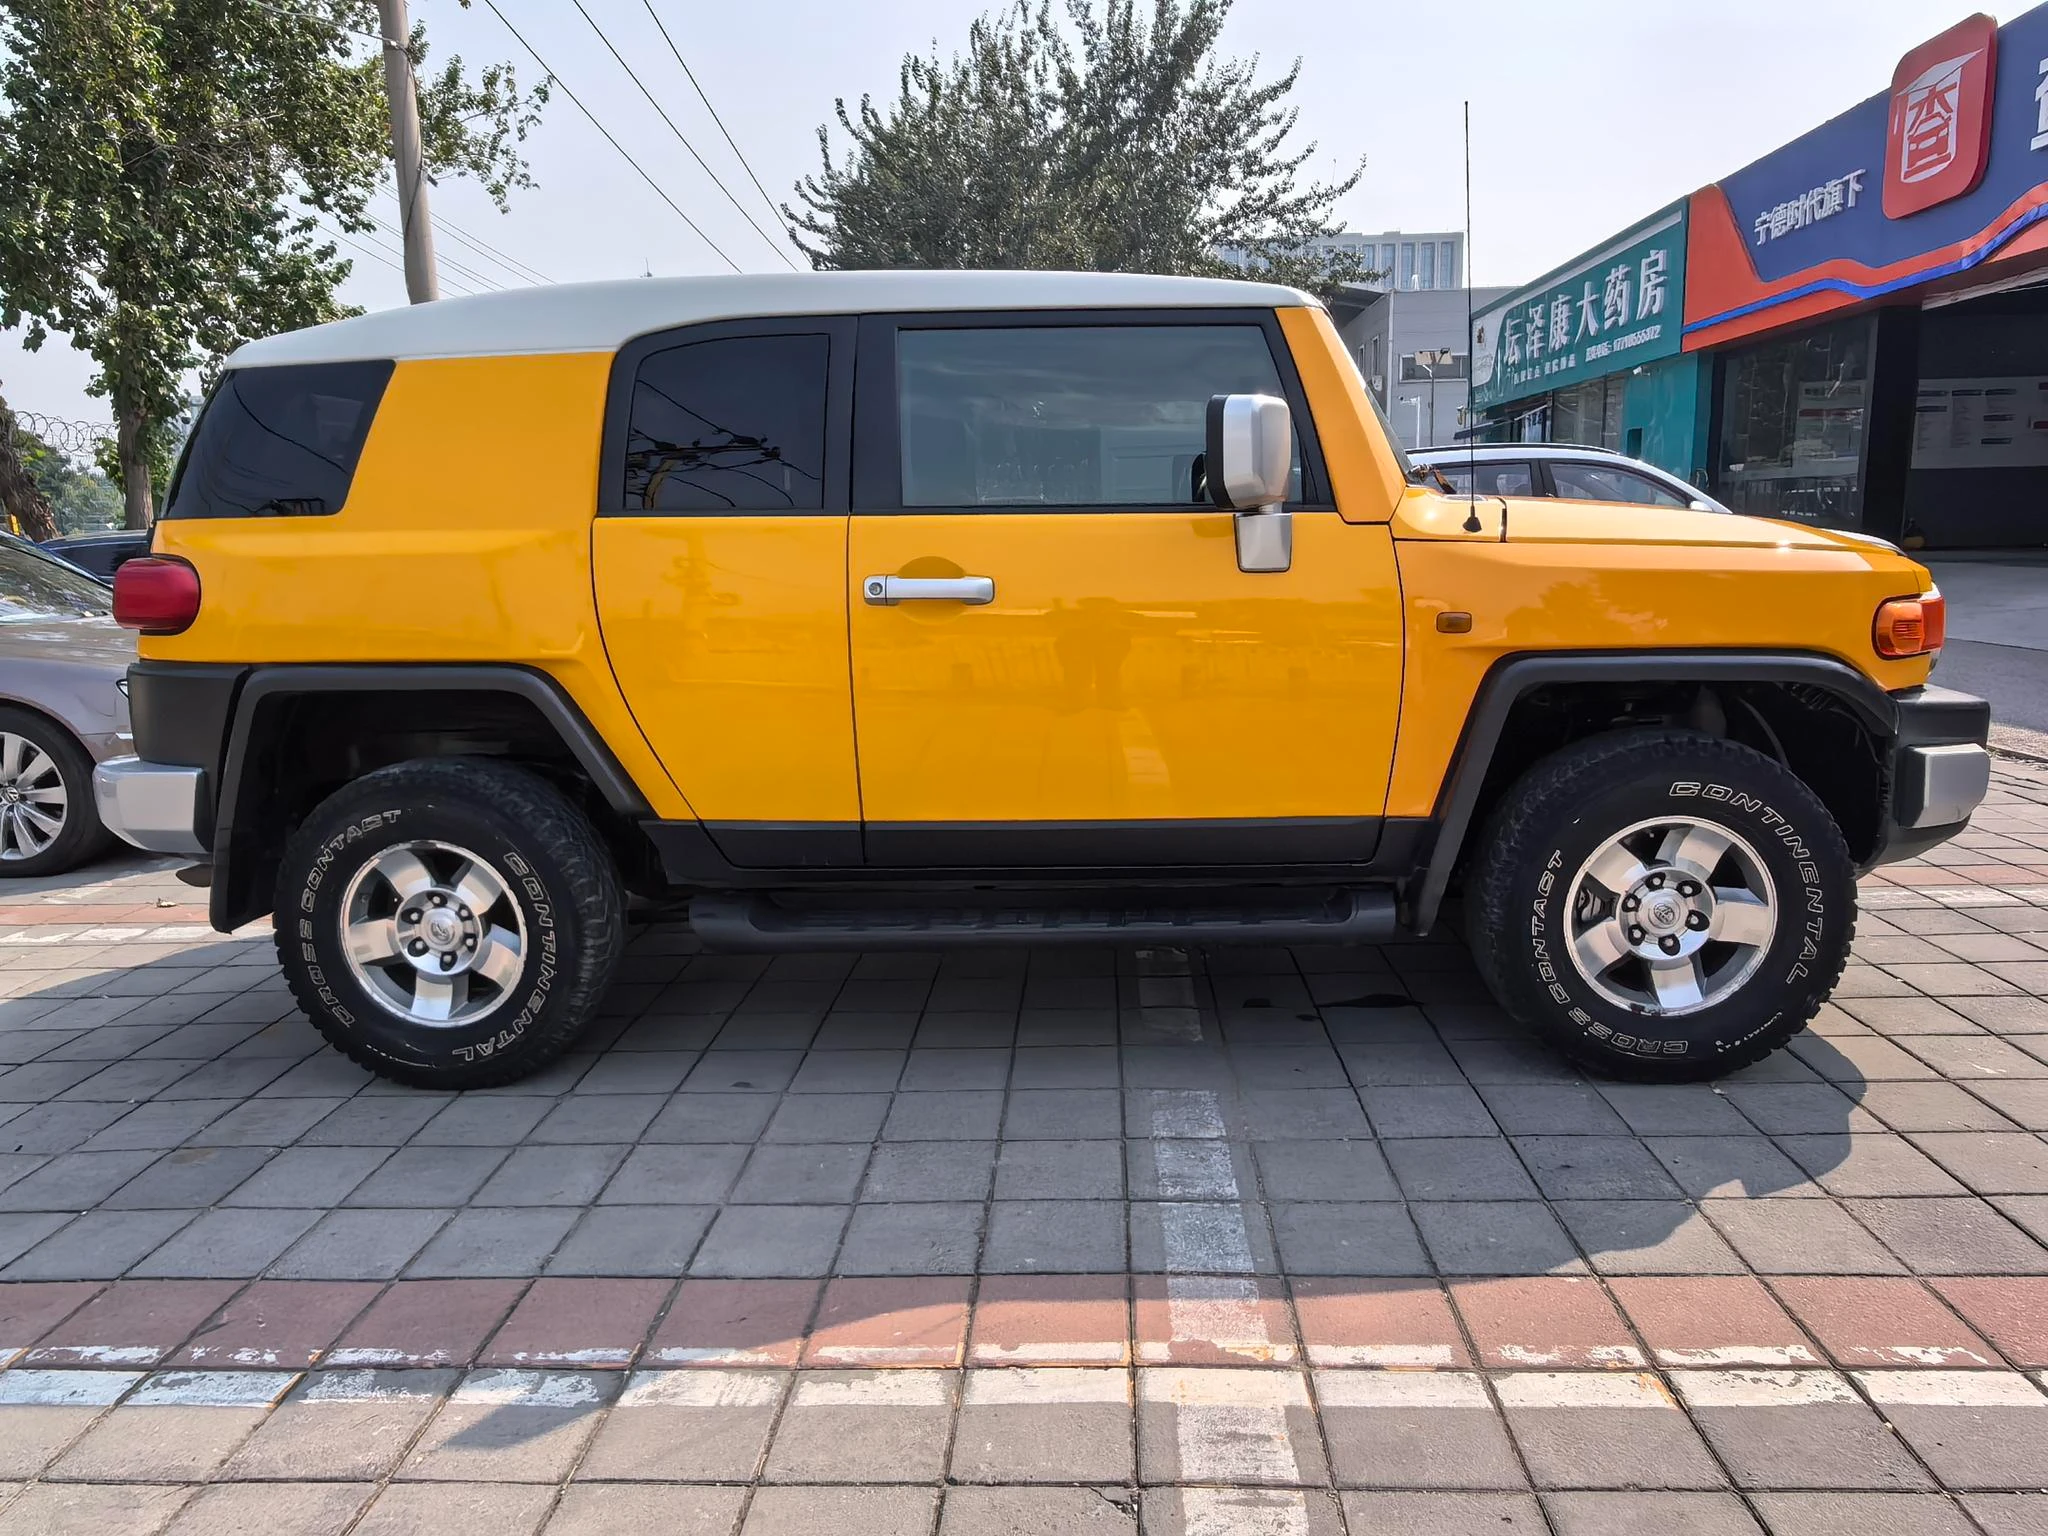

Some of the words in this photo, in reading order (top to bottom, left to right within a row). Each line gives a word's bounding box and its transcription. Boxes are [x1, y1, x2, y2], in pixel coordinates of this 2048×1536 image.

[1753, 168, 1867, 246] 宁德时代旗下
[301, 808, 402, 913] CONTACT
[1668, 781, 1825, 984] CONTINENTAL
[299, 918, 355, 1028] CROSS
[452, 851, 557, 1062] CONTINENTAL
[1531, 849, 1571, 1005] CONTACT
[1568, 1007, 1689, 1055] CROSS
